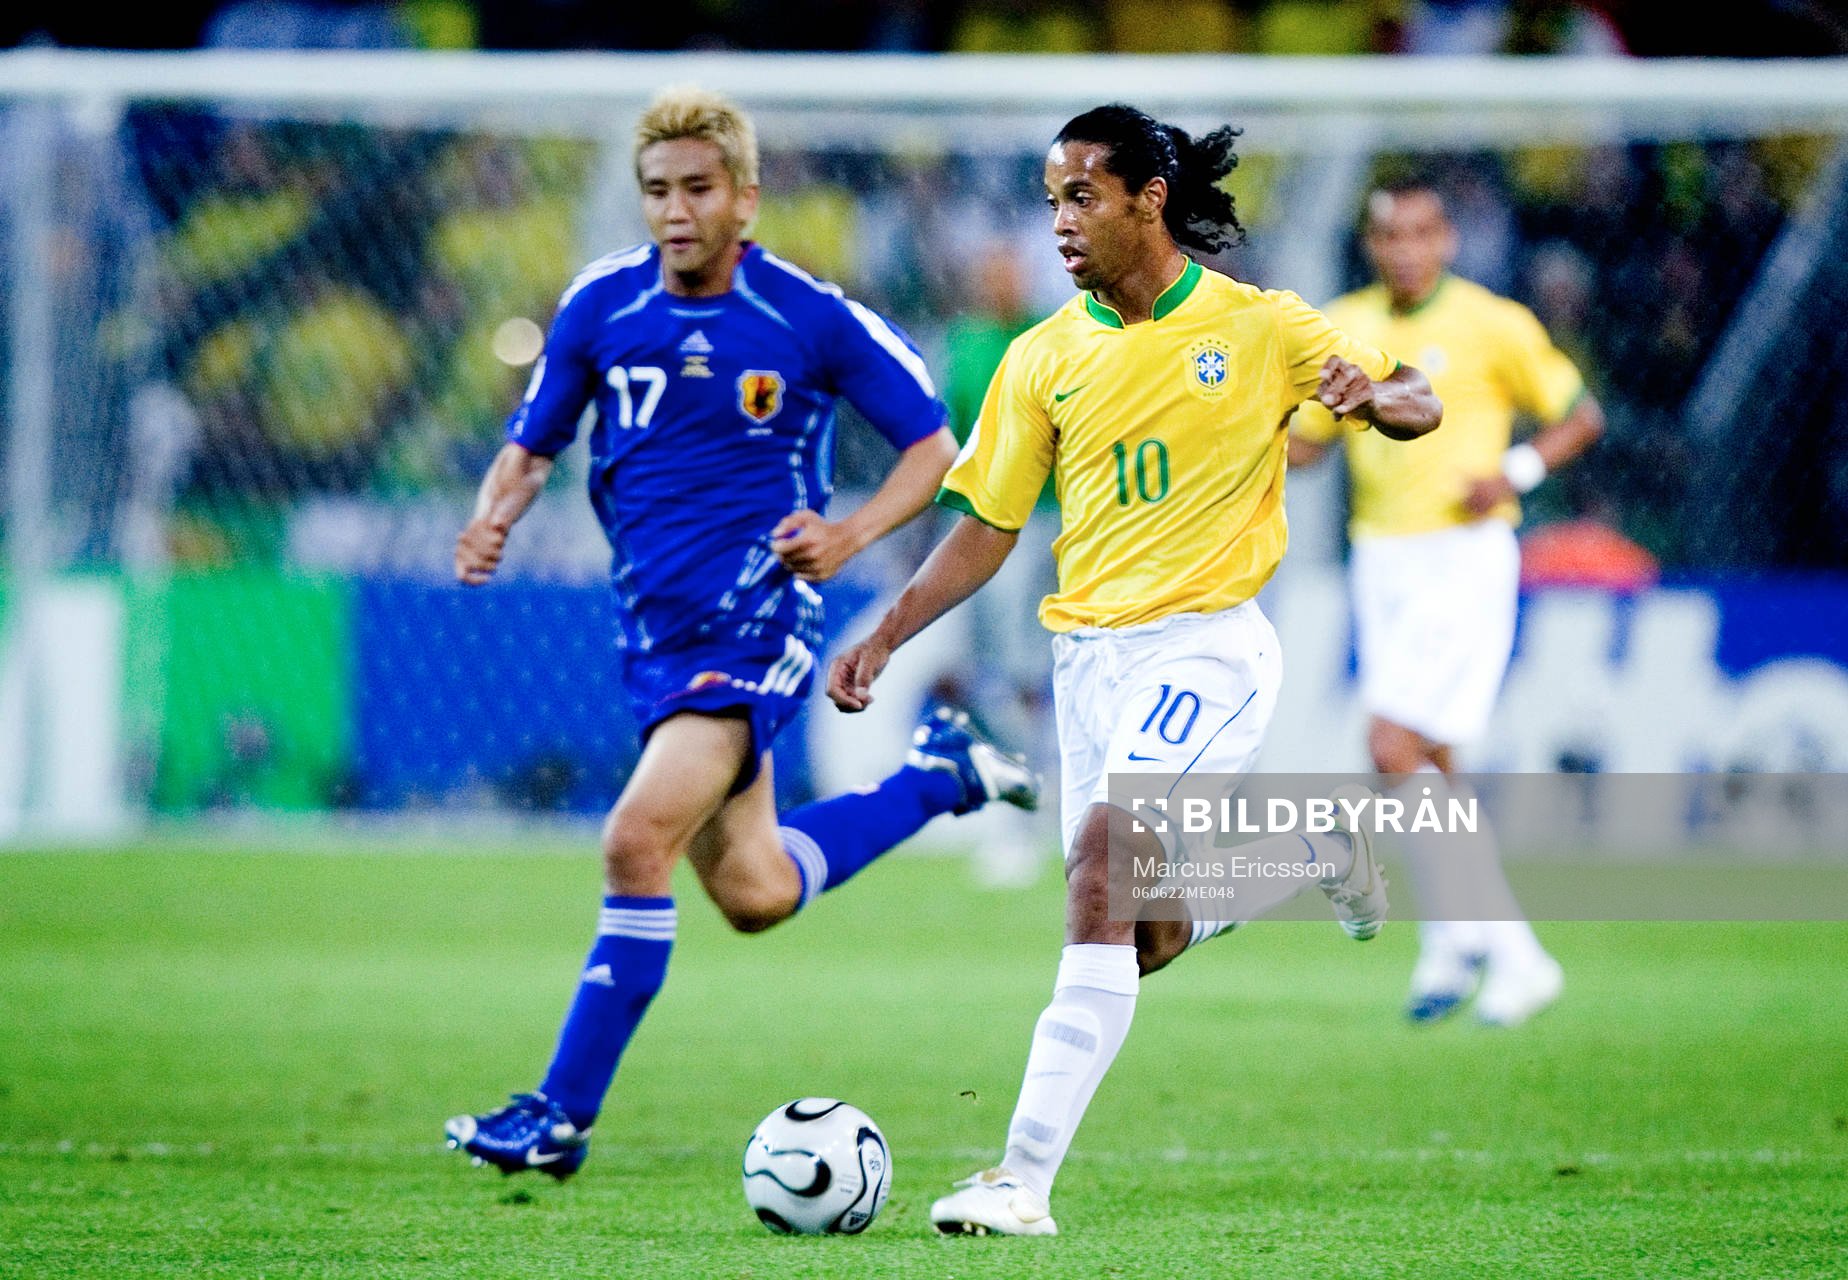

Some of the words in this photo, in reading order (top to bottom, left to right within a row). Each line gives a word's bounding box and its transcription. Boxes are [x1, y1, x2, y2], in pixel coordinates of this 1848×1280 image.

[606, 366, 667, 429] 17
[1112, 438, 1170, 506] 10
[1140, 683, 1201, 745] 10
